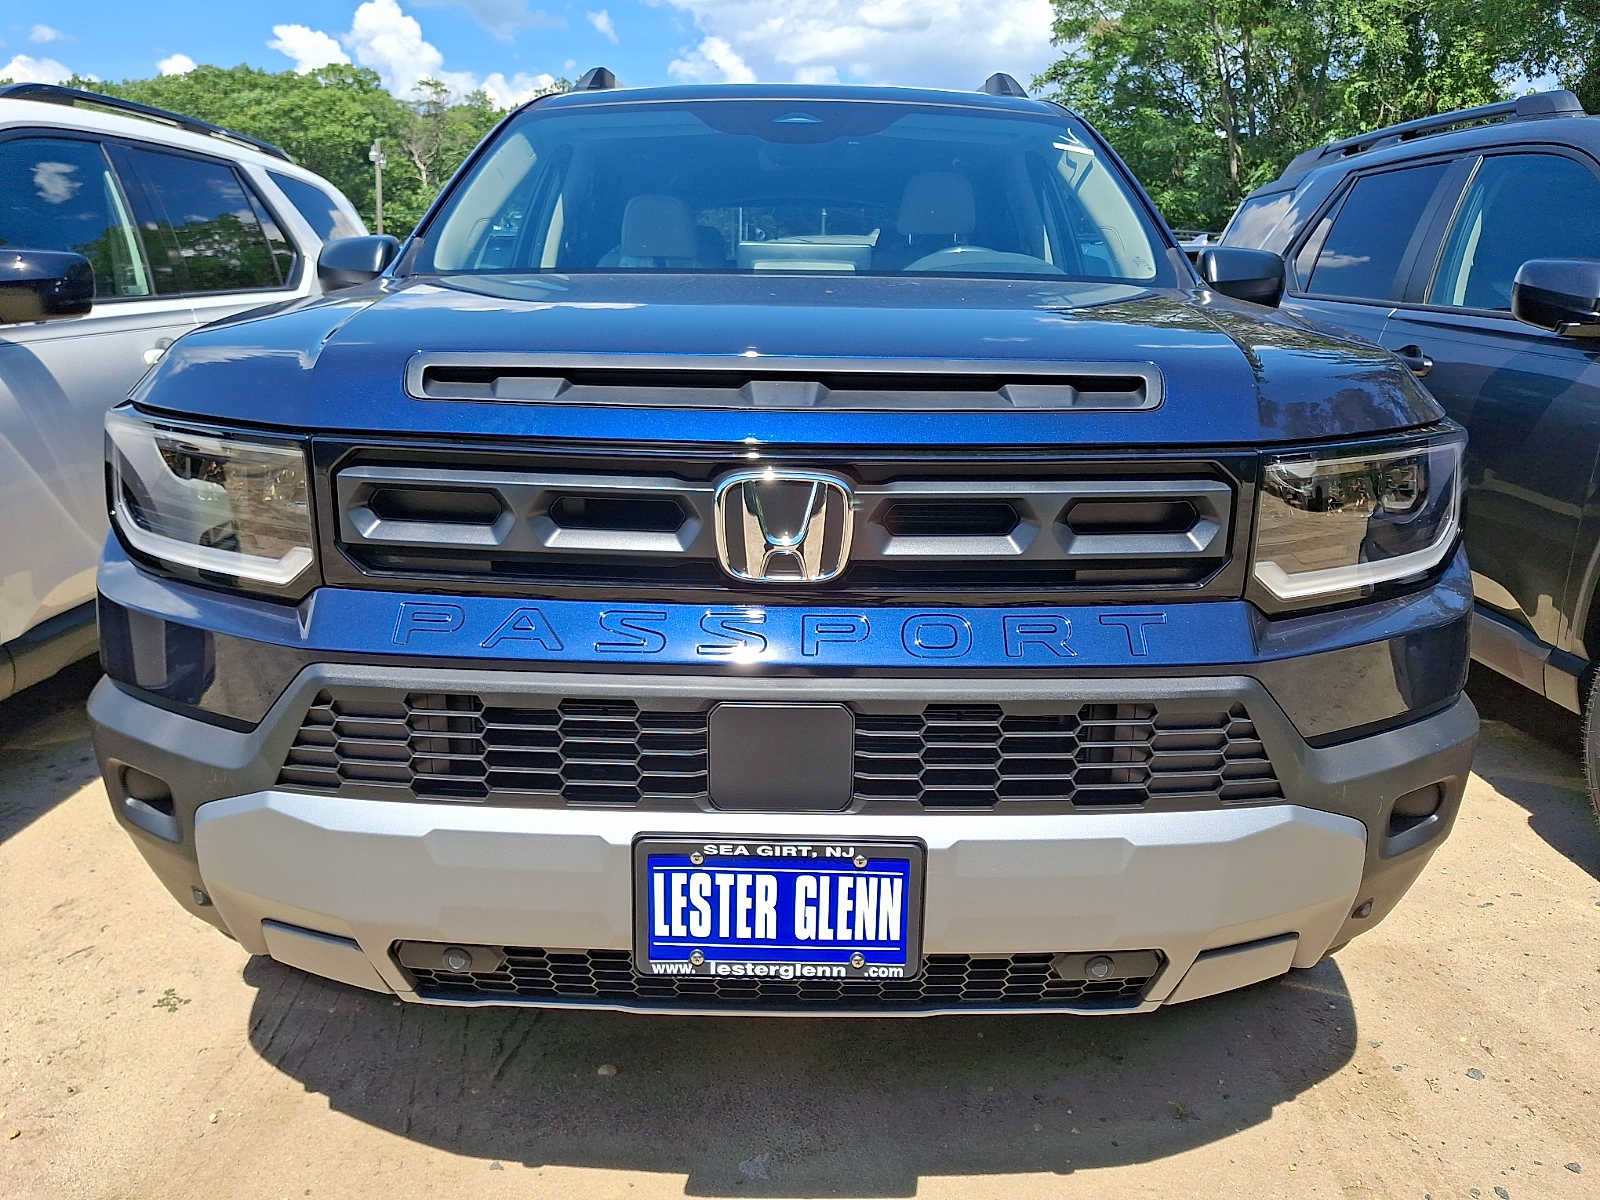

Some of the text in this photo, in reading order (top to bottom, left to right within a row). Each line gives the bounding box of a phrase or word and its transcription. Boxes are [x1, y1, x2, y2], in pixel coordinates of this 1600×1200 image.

[392, 601, 1167, 658] PASSPORT
[703, 844, 856, 858] SEA GIRT, NJ
[653, 872, 903, 941] LESTER GLENN
[651, 963, 696, 975] www.
[710, 961, 846, 979] lesterglenn
